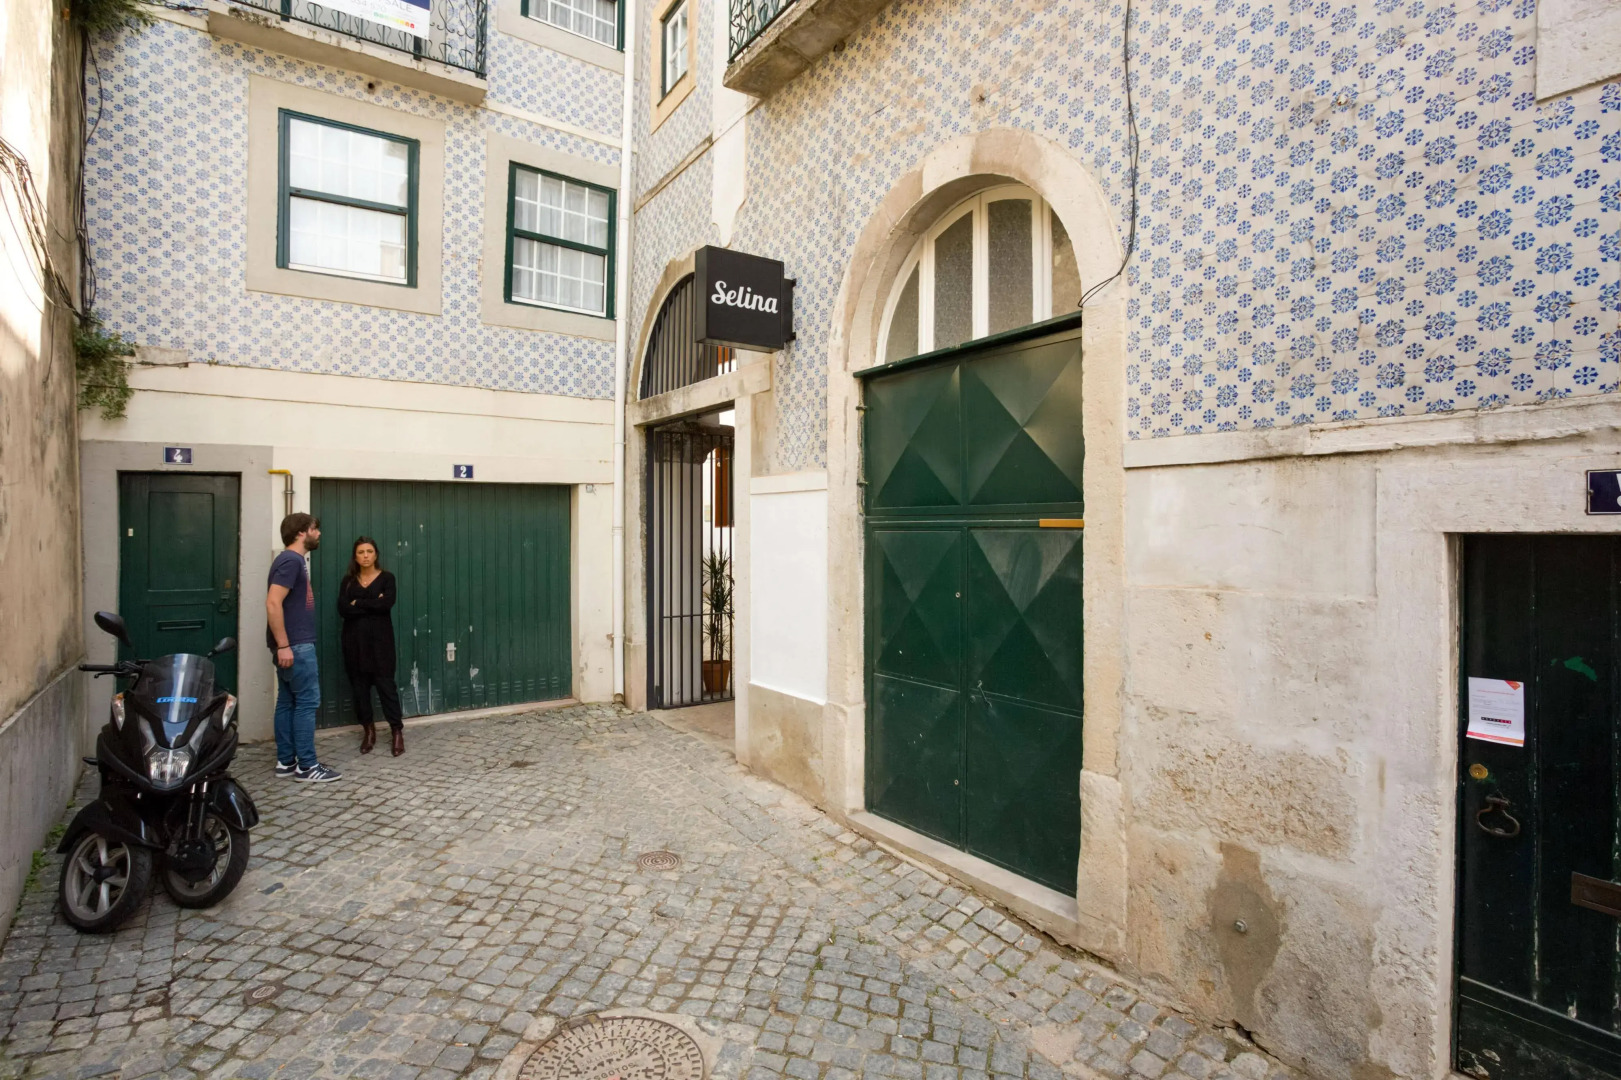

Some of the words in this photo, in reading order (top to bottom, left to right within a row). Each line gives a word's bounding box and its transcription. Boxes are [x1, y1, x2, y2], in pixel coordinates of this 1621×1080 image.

[711, 280, 778, 314] Selina
[173, 449, 183, 463] 4
[460, 465, 467, 478] 2
